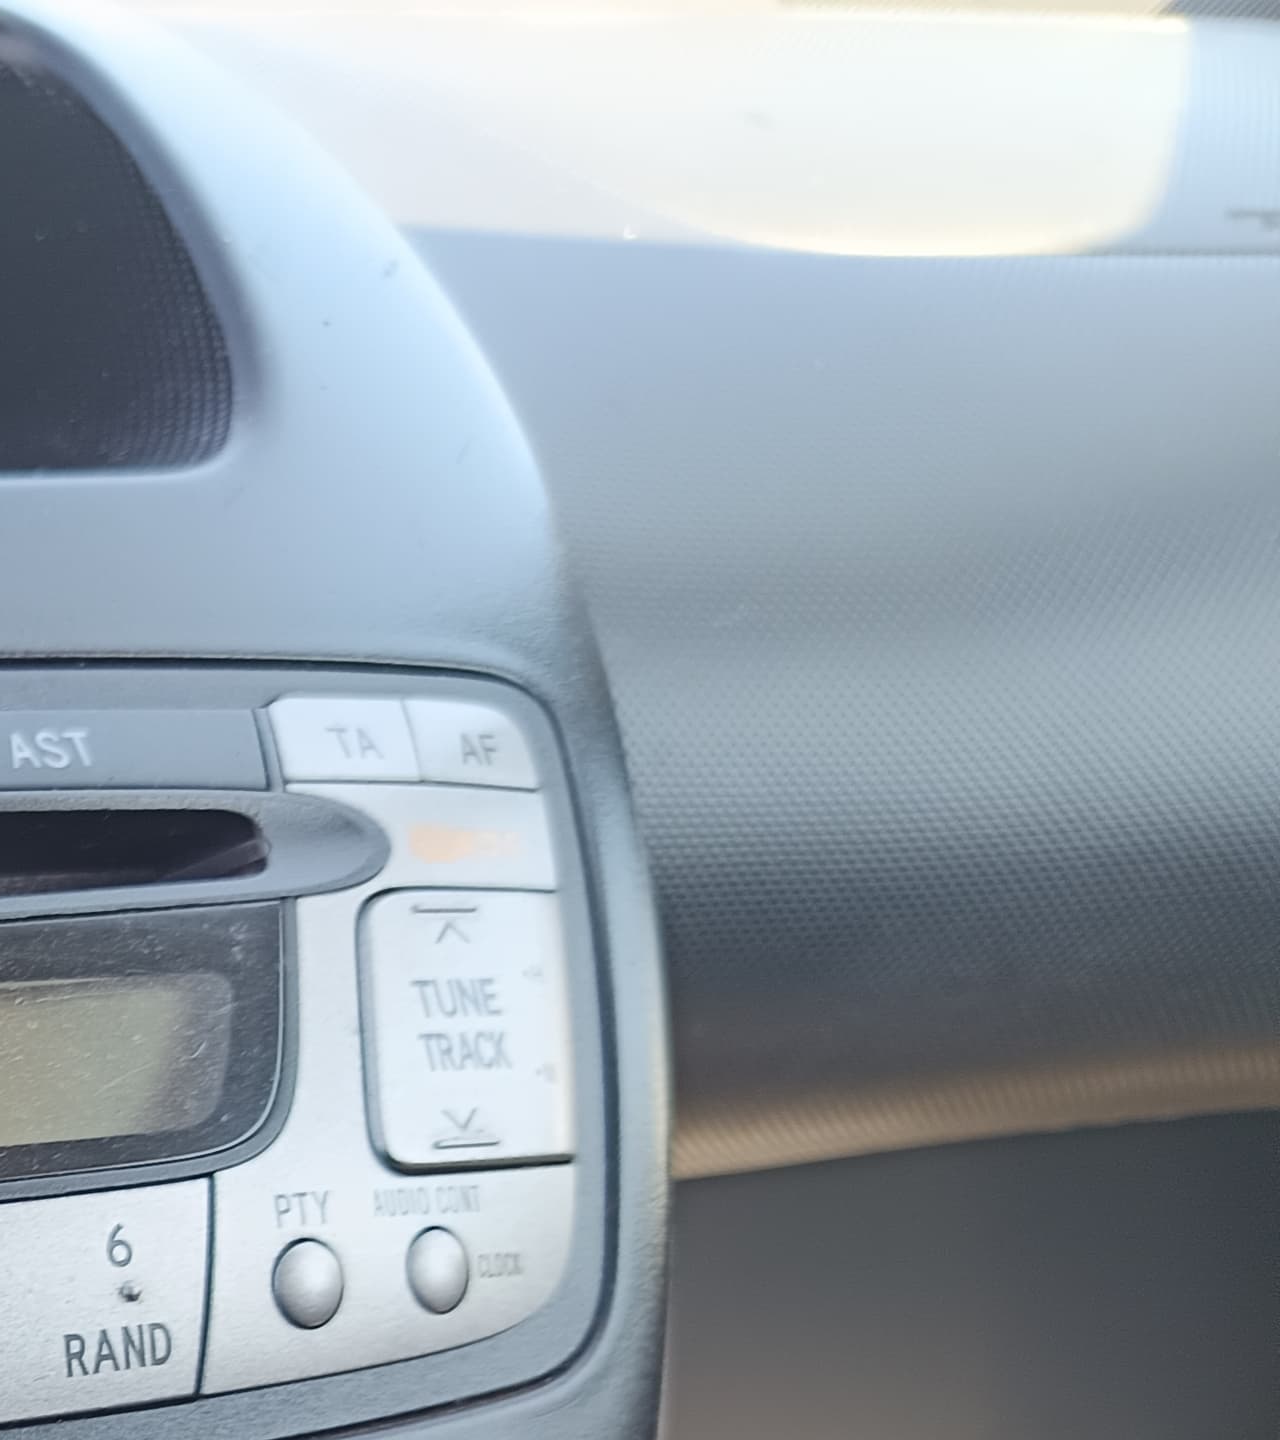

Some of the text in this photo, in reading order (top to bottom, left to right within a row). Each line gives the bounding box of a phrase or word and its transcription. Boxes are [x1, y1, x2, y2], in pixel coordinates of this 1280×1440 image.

[9, 730, 93, 770] AST
[325, 727, 384, 761] TA
[459, 733, 501, 767] AF
[410, 977, 504, 1019] TUNE
[417, 1031, 514, 1072] TRACK
[273, 1190, 331, 1229] PTY
[106, 1222, 134, 1268] 6
[63, 1321, 173, 1379] RAND
